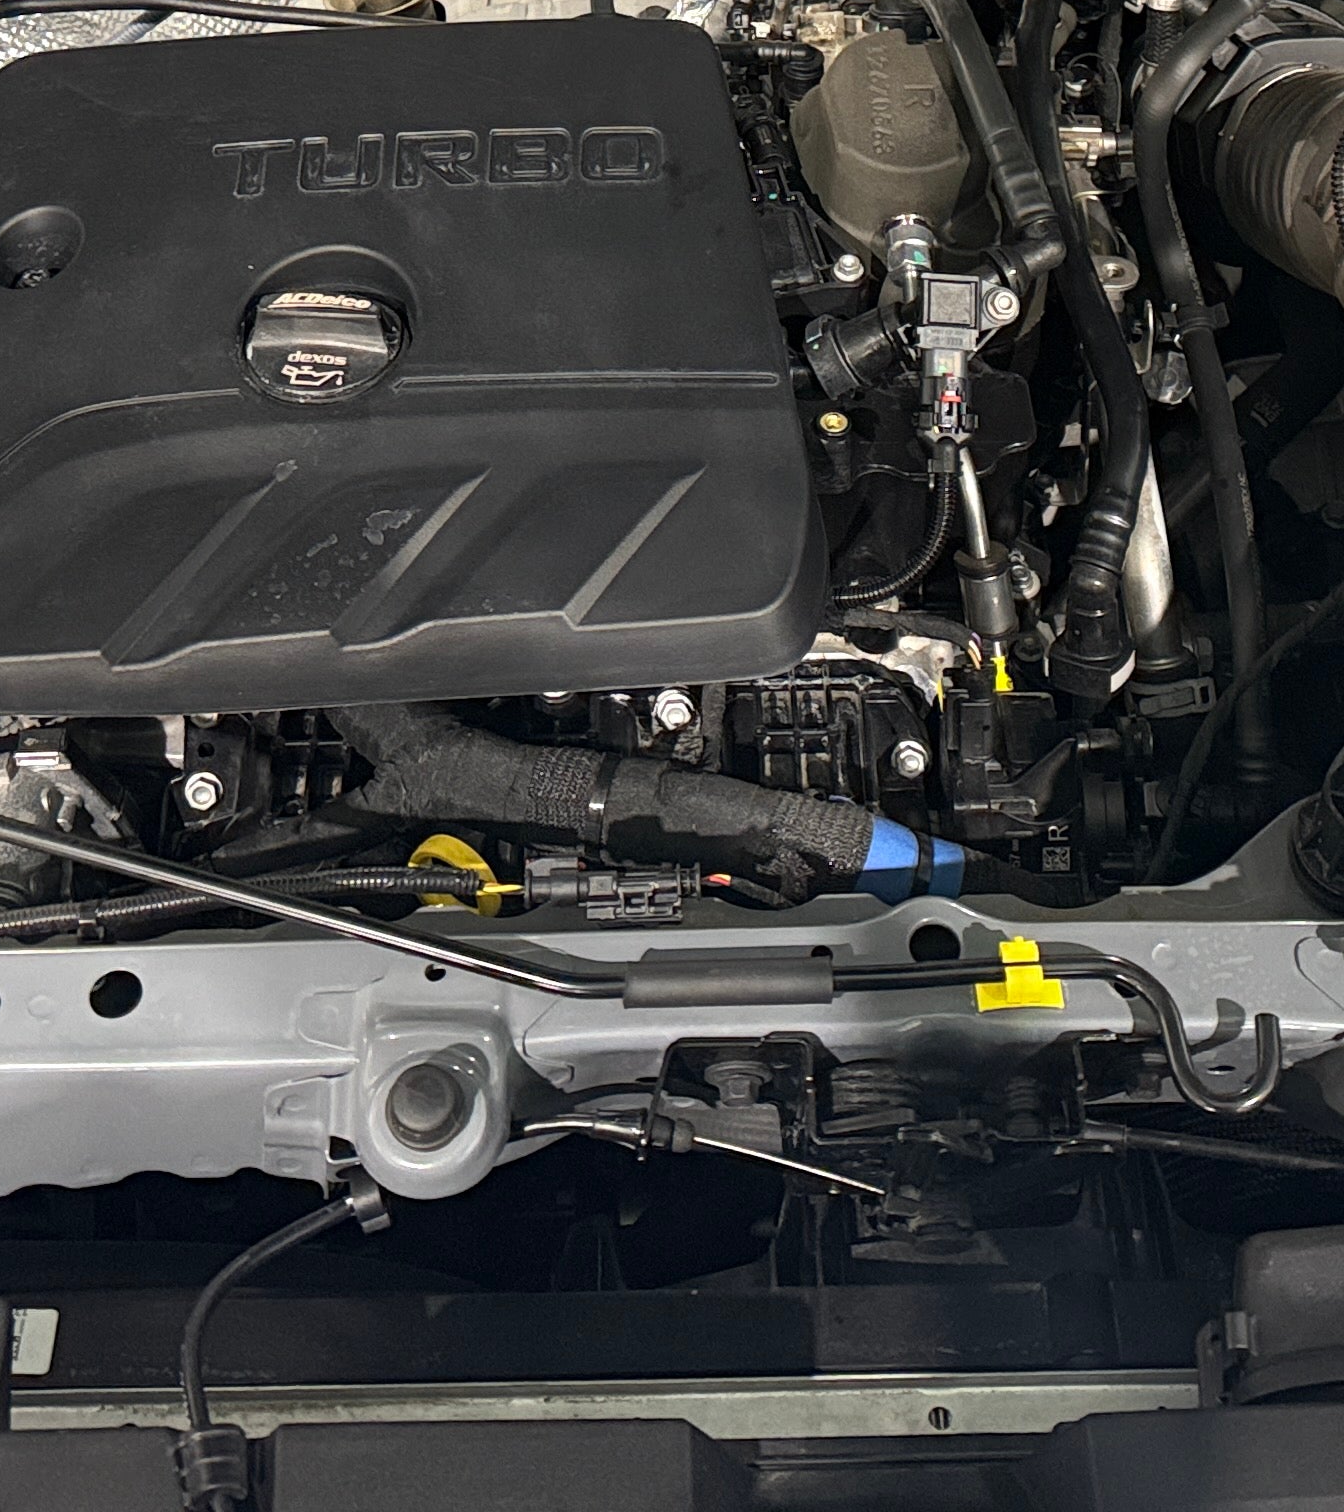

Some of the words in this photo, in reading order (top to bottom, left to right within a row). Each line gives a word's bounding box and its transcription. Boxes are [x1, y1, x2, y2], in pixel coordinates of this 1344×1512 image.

[901, 83, 936, 108] R
[212, 126, 664, 199] TURBO
[272, 292, 372, 309] ACDelco
[287, 351, 348, 366] dexos
[1048, 825, 1069, 842] R
